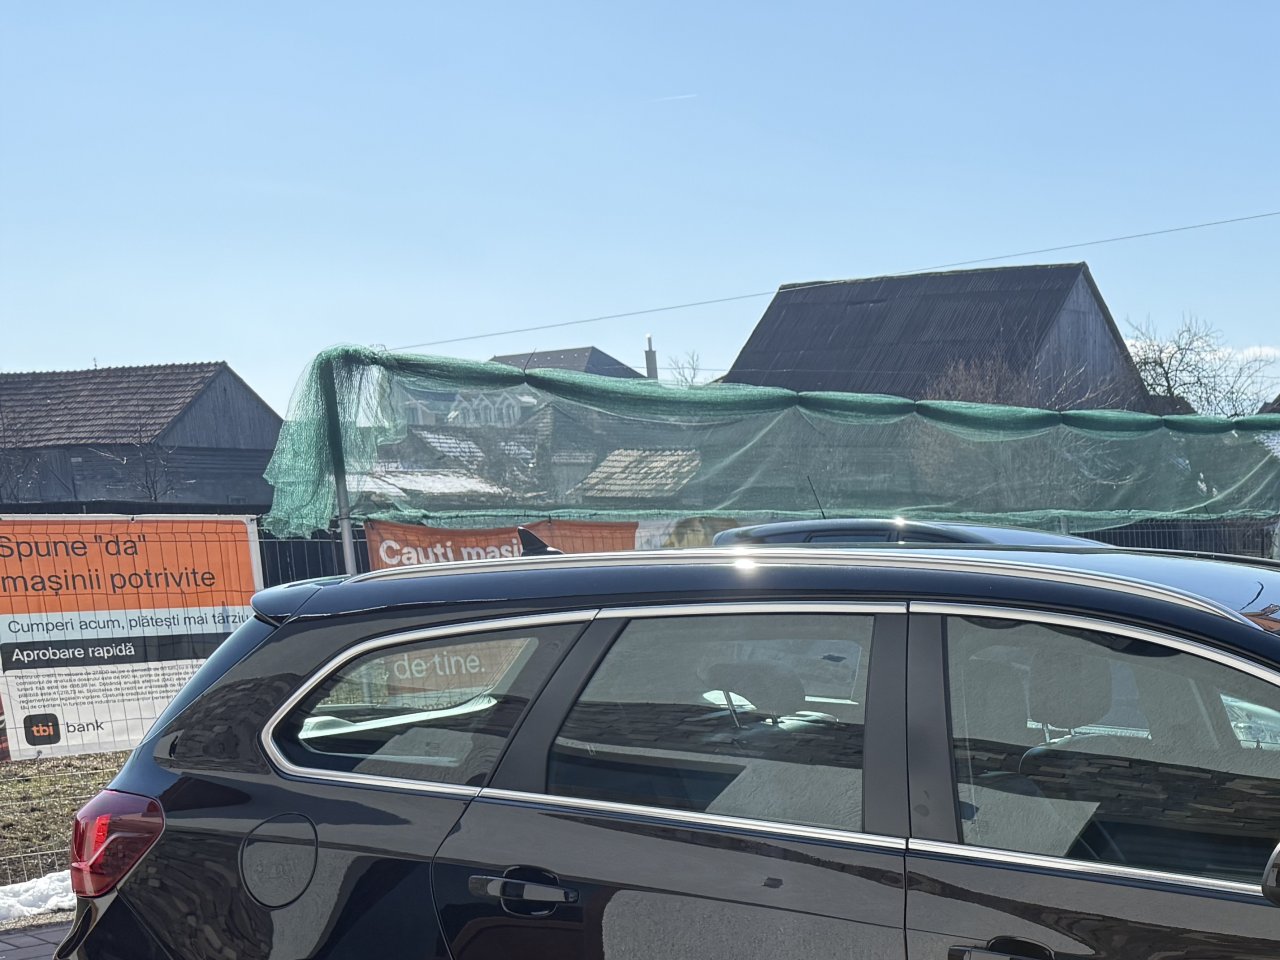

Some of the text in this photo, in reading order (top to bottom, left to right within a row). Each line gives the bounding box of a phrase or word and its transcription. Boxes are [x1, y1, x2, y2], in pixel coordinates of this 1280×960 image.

[0, 534, 146, 562] Spune "da"
[461, 538, 524, 561] masi
[1, 567, 216, 596] mașinii potrivite
[8, 619, 74, 634] Cumperi
[79, 617, 125, 631] acum,
[129, 614, 180, 629] plătești
[184, 613, 208, 625] mai
[12, 643, 135, 663] Aprobare rapidă
[393, 651, 485, 679] de tine.
[32, 720, 104, 736] tbi bank
